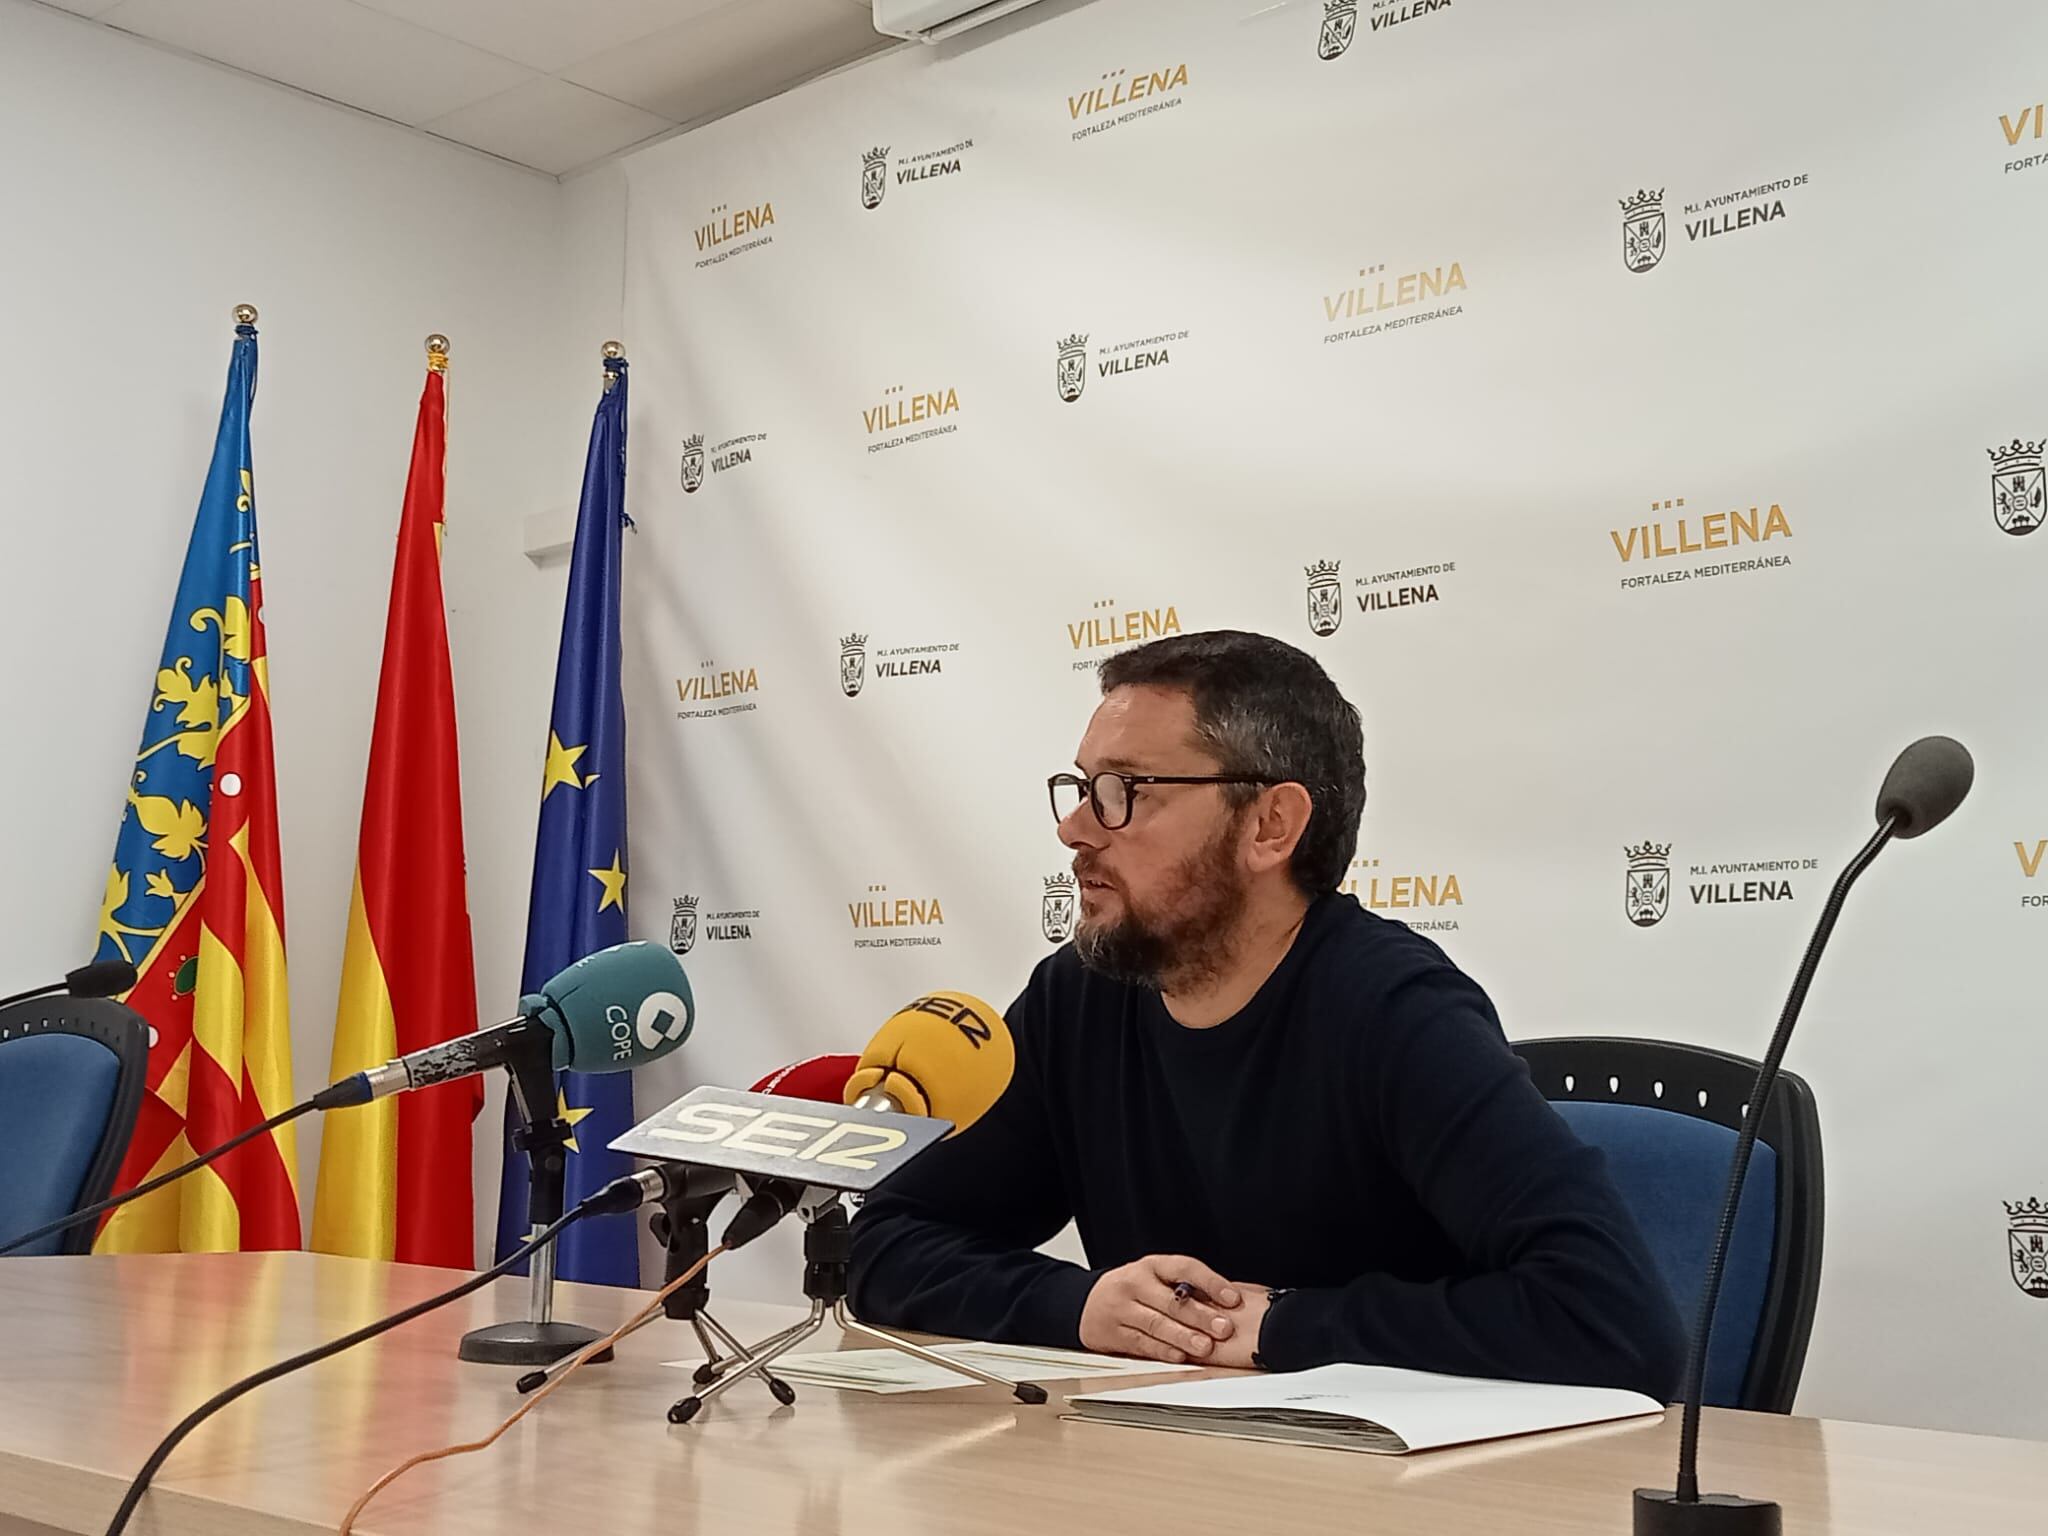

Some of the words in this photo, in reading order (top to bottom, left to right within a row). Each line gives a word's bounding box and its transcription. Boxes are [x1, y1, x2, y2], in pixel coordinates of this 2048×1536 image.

[1371, 0, 1451, 31] VILLENA
[1068, 64, 1188, 120] VILLENA
[965, 139, 974, 149] DE
[1072, 120, 1116, 141] FORTALEZA
[896, 159, 961, 185] VILLENA
[1704, 179, 1790, 210] AYUNTAMIENTO
[1794, 174, 1808, 187] DE
[694, 202, 774, 251] VILLENA
[1685, 200, 1786, 241] VILLENA
[1323, 262, 1468, 322] VILLENA
[1113, 332, 1176, 352] AYUNTAMIENTO
[1178, 330, 1189, 340] DE
[1324, 324, 1382, 344] FORTALEZA
[1098, 350, 1169, 377] VILLENA
[862, 387, 959, 434] VILLENA
[711, 448, 752, 474] VILLENA
[1610, 504, 1792, 562] VILLENA
[1372, 565, 1440, 584] AYUNTAMIENTO
[1442, 562, 1456, 572] DE
[1621, 570, 1691, 589] FORTALEZA
[1694, 555, 1791, 578] MEDITERRÁNEA
[1357, 584, 1439, 612] VILLENA
[1068, 606, 1182, 650] VILLENA
[890, 644, 948, 656] AYUNTAMIENTO
[948, 643, 960, 652] DE
[876, 659, 942, 678] VILLENA
[676, 668, 758, 702] VILLENA
[1710, 860, 1800, 874] AYUNTAMIENTO
[1802, 859, 1818, 869] DE
[1689, 880, 1794, 904] VILLENA
[848, 899, 944, 928] VILLENA
[706, 925, 751, 940] VILLENA
[605, 1004, 632, 1061] COPE
[648, 1103, 908, 1170] SER
